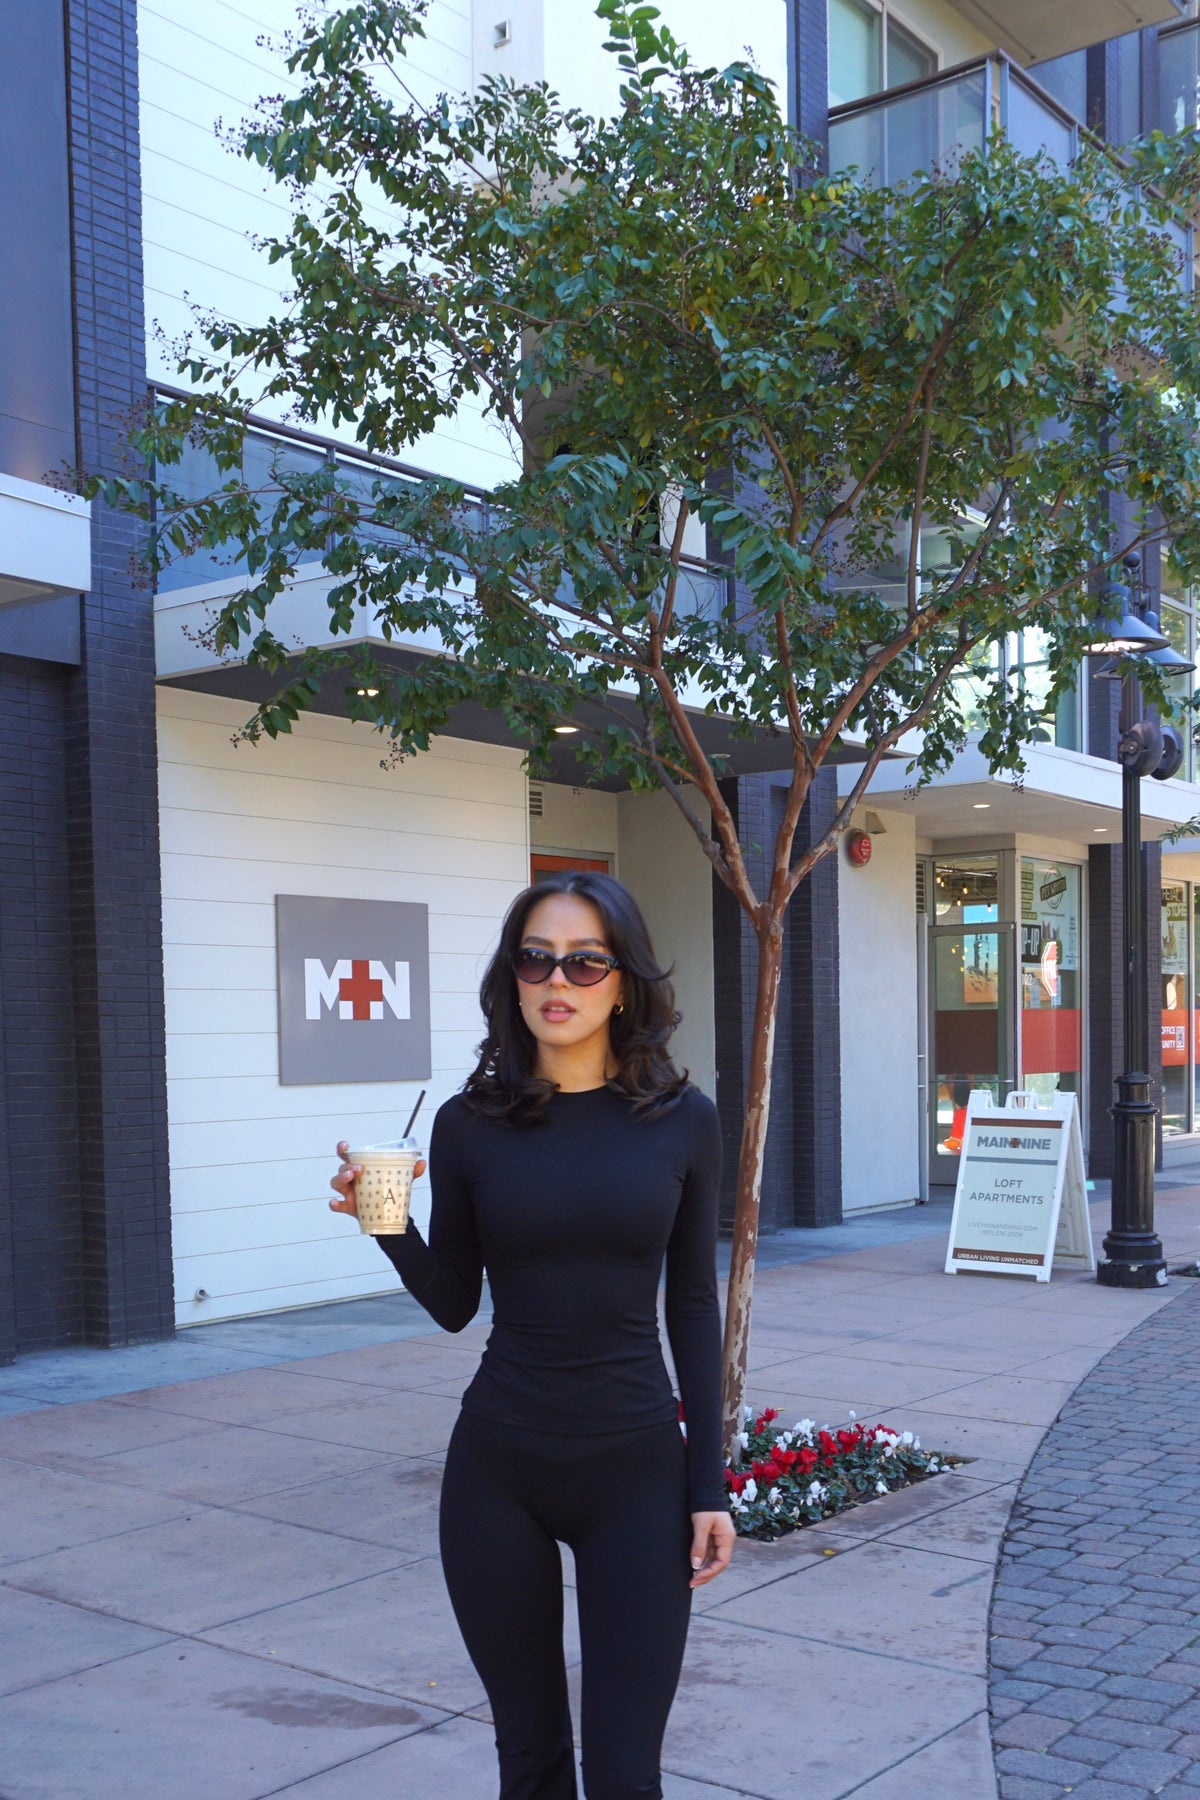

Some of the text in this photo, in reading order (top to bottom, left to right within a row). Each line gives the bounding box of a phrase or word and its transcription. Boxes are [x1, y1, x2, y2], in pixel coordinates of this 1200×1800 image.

[994, 1178, 1023, 1189] LOFT
[970, 1192, 1044, 1205] APARTMENTS
[979, 1254, 1000, 1262] LIVING
[1001, 1256, 1038, 1265] UNMATCHED
